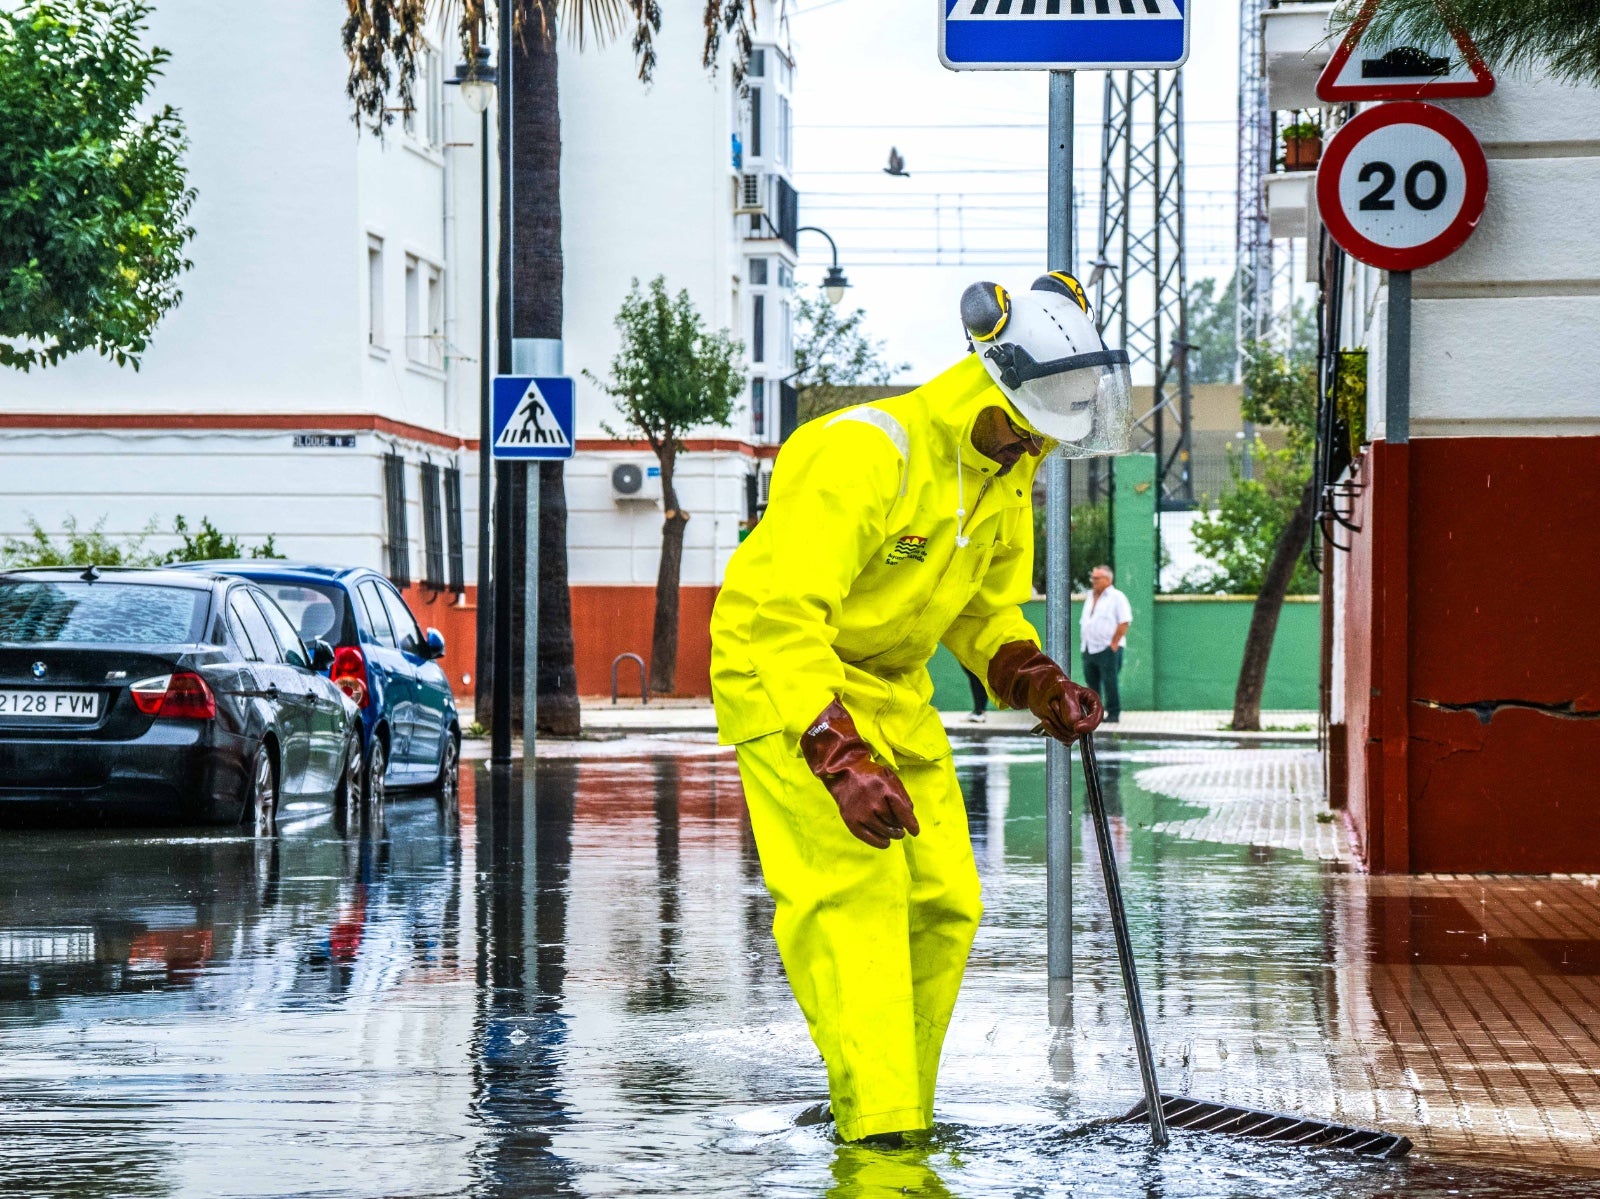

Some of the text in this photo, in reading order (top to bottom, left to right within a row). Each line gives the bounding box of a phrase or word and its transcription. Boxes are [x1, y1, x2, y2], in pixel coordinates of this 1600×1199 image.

[1358, 160, 1447, 211] 20
[0, 694, 94, 714] 2128 FVM
